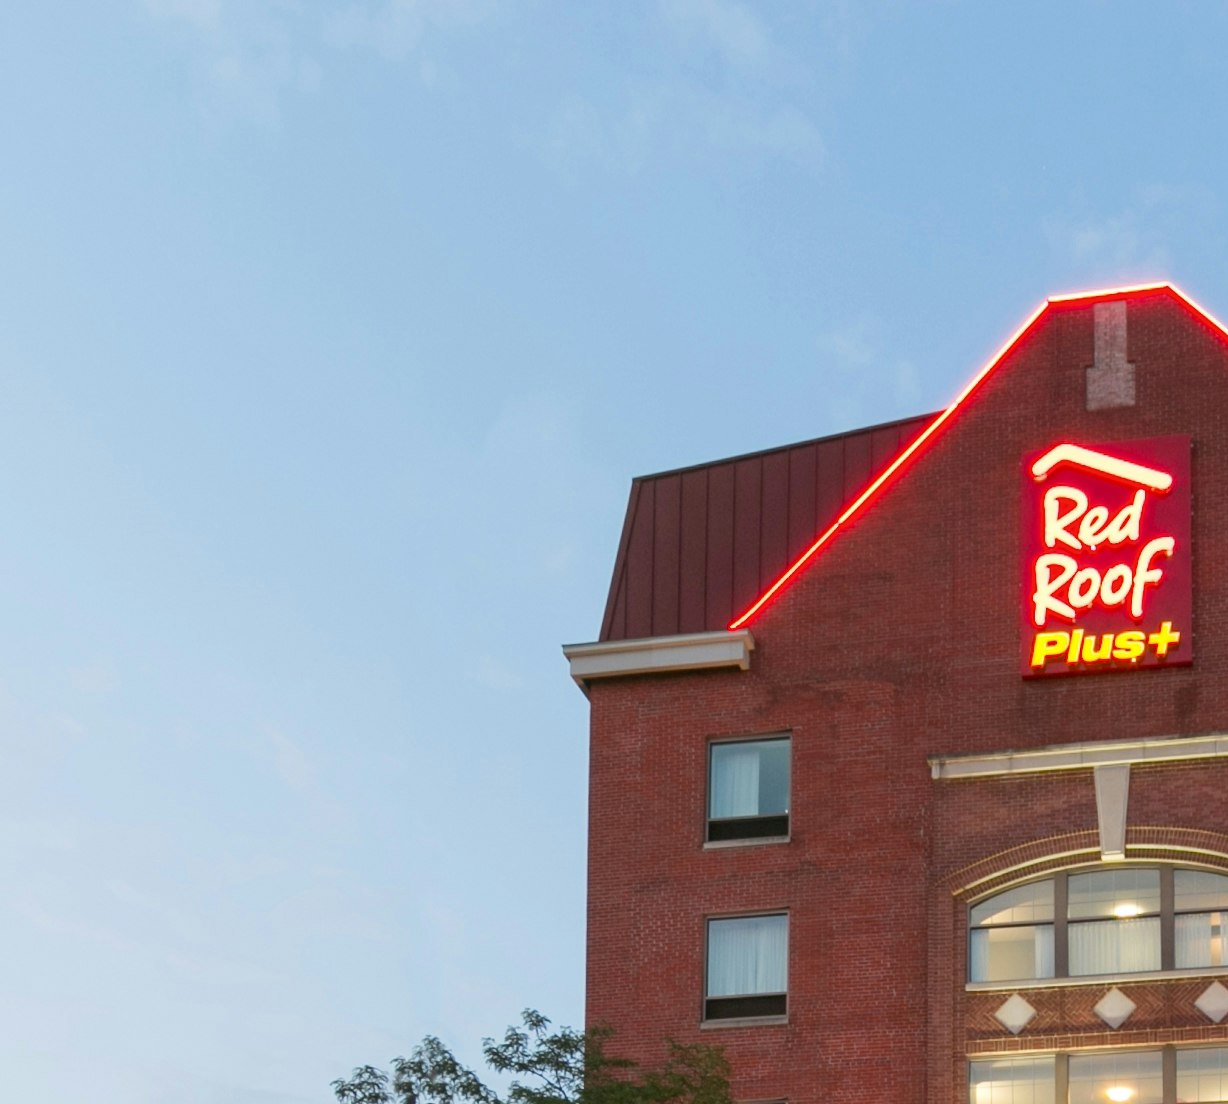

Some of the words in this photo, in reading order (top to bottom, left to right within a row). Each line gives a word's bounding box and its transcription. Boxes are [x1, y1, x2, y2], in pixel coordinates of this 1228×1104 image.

[1044, 486, 1145, 549] Red
[1033, 536, 1175, 625] Roof
[1031, 621, 1180, 666] Plus+
